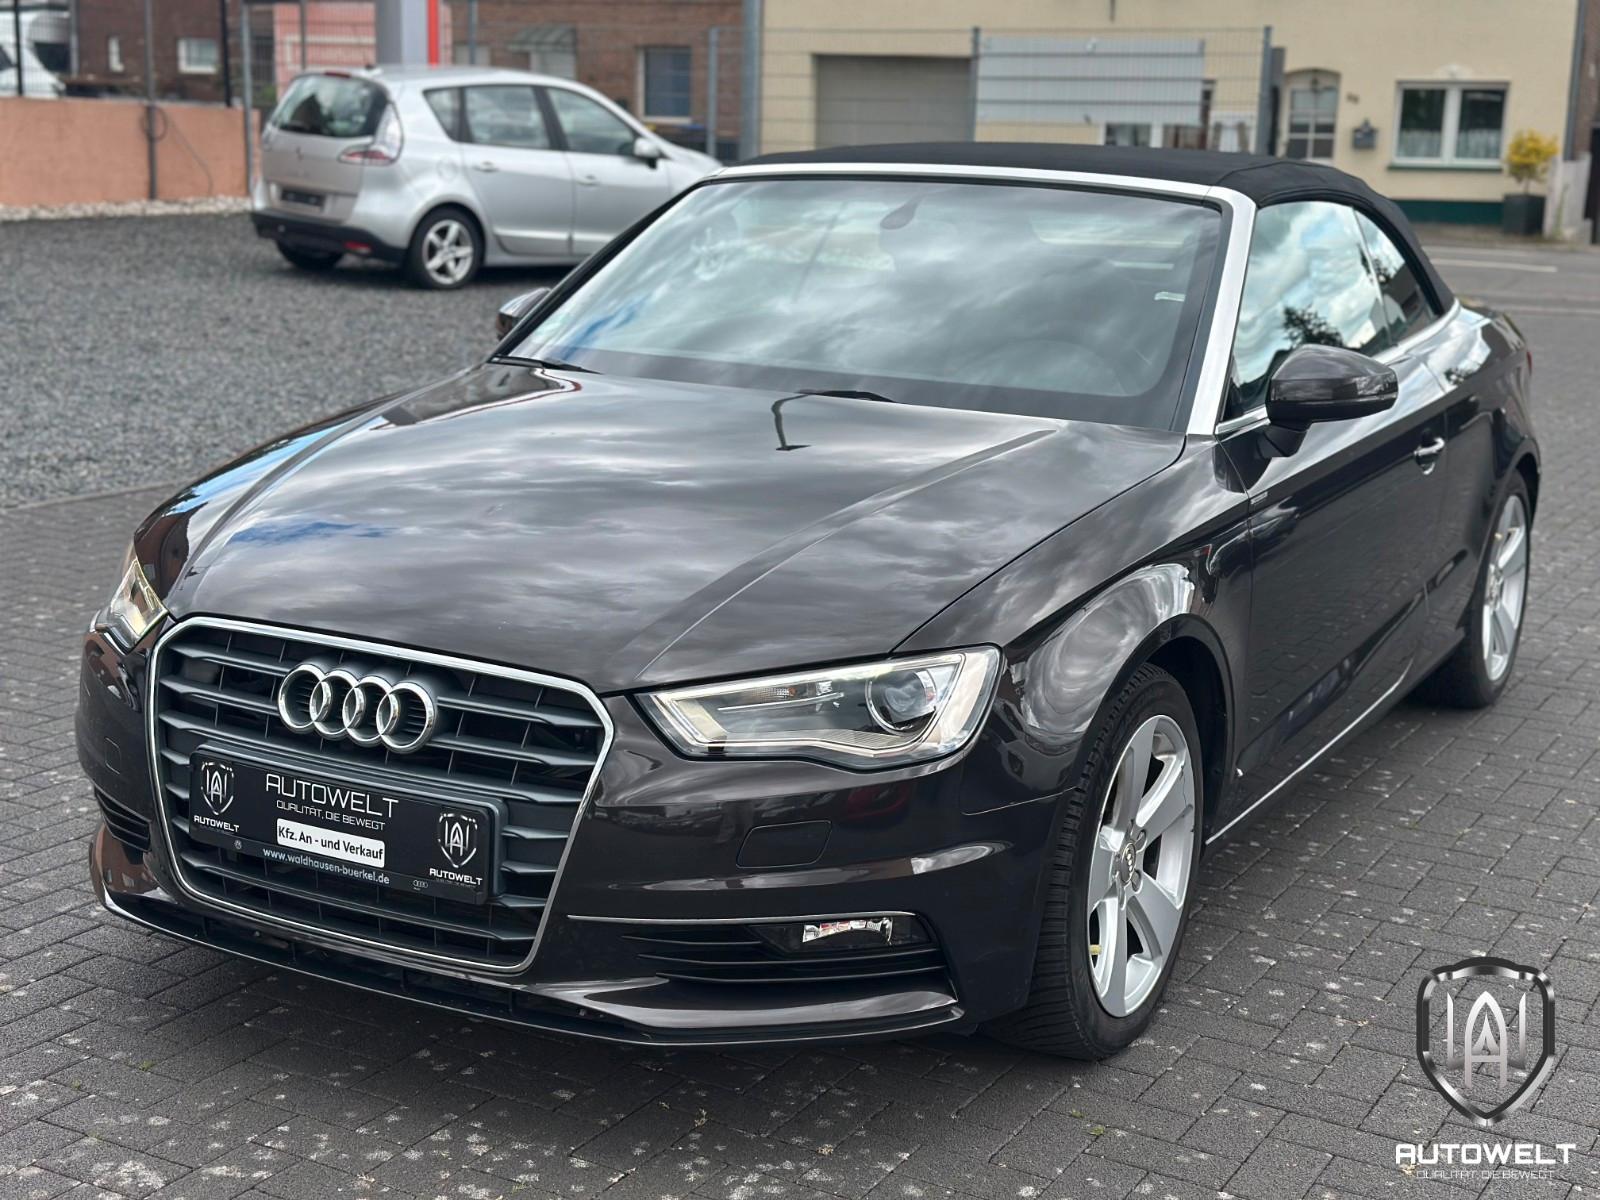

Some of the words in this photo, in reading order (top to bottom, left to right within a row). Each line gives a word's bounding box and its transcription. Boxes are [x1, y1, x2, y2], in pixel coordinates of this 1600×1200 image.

[266, 773, 399, 818] AUTOWELT
[193, 814, 240, 833] AUTOWELT
[325, 811, 341, 822] DIE
[342, 814, 386, 831] BEWEGT
[278, 825, 298, 842] Kfz.
[298, 831, 313, 845] An
[321, 838, 341, 851] und
[342, 840, 384, 861] Verkauf
[262, 848, 390, 886] www.waldhausen-buerkel.de
[429, 867, 483, 886] AUTOWELT
